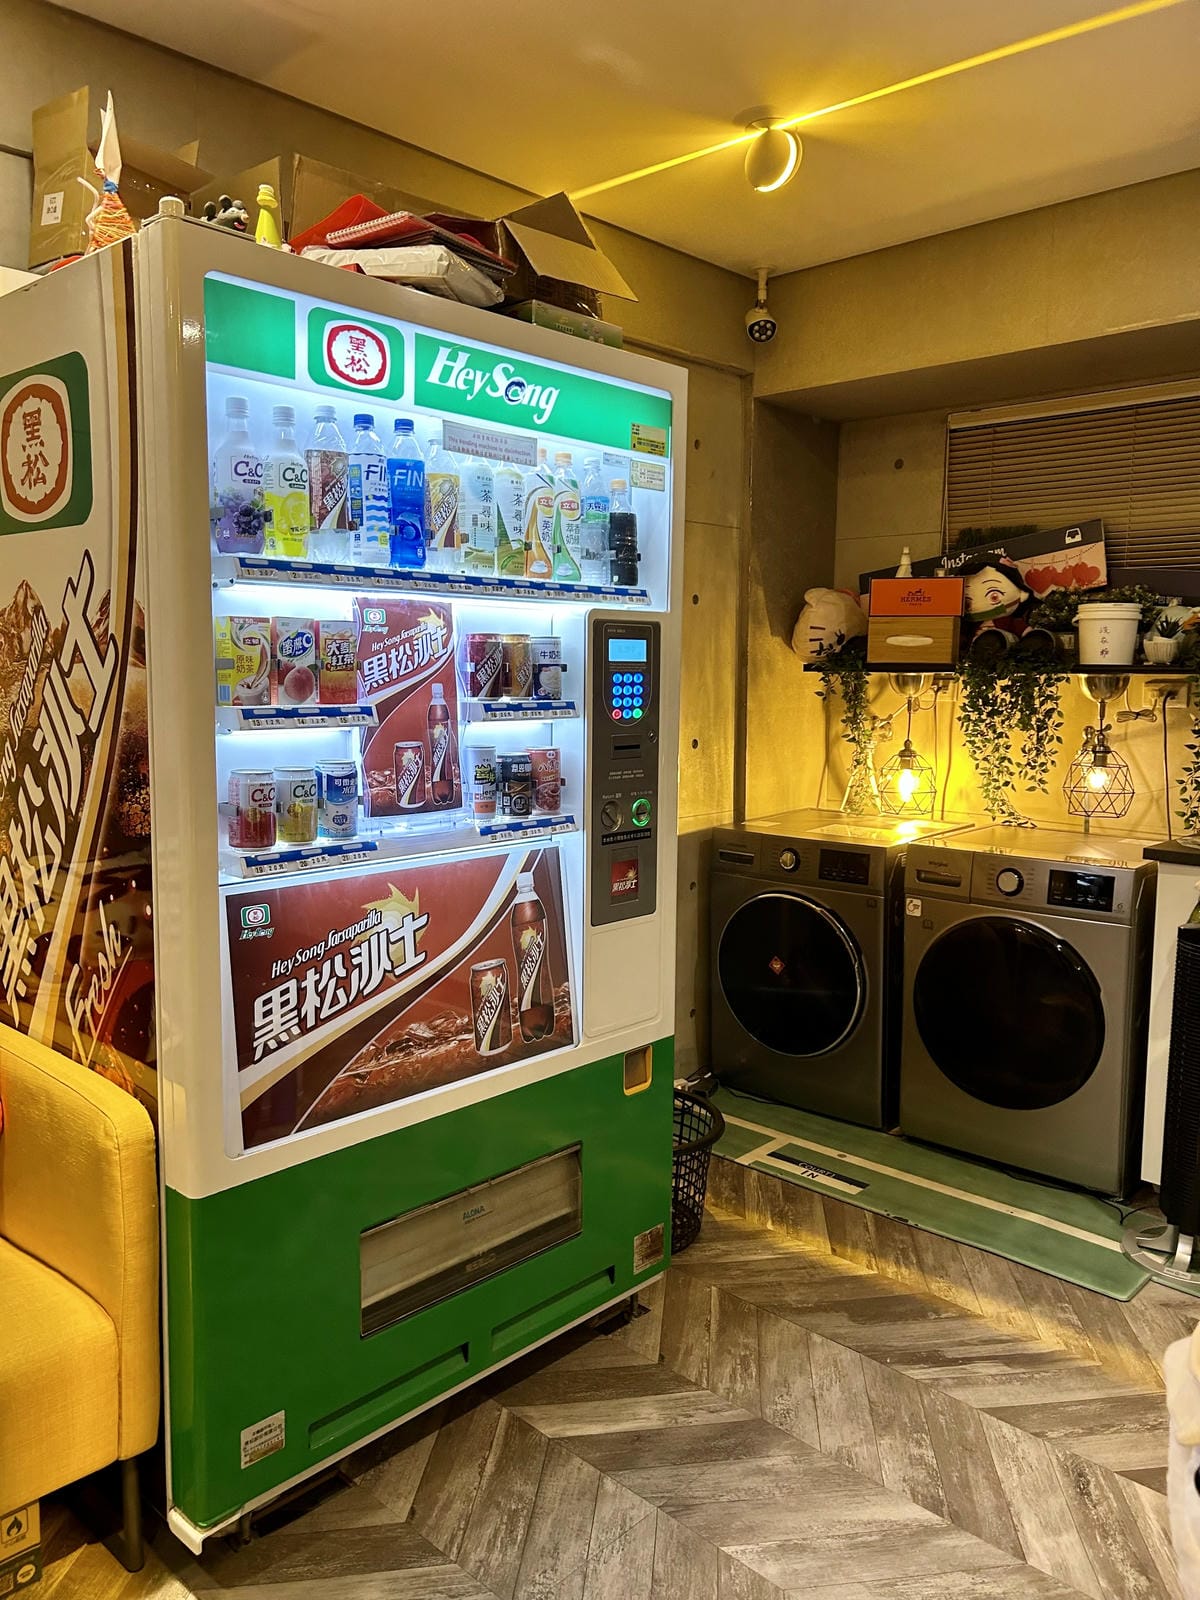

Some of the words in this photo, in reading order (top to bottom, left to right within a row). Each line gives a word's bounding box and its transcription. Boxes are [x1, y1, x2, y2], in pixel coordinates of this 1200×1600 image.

[345, 336, 371, 374] 黑松
[21, 407, 49, 490] 黑松
[234, 460, 263, 478] C&C
[282, 467, 308, 483] C&C
[393, 469, 423, 487] FIN
[363, 627, 448, 691] 黑松沙士
[251, 787, 275, 802] C&C
[293, 784, 316, 799] C&C
[325, 909, 382, 951] Sarsaparilla
[253, 913, 431, 1063] 黑松沙士
[801, 1170, 819, 1178] IN
